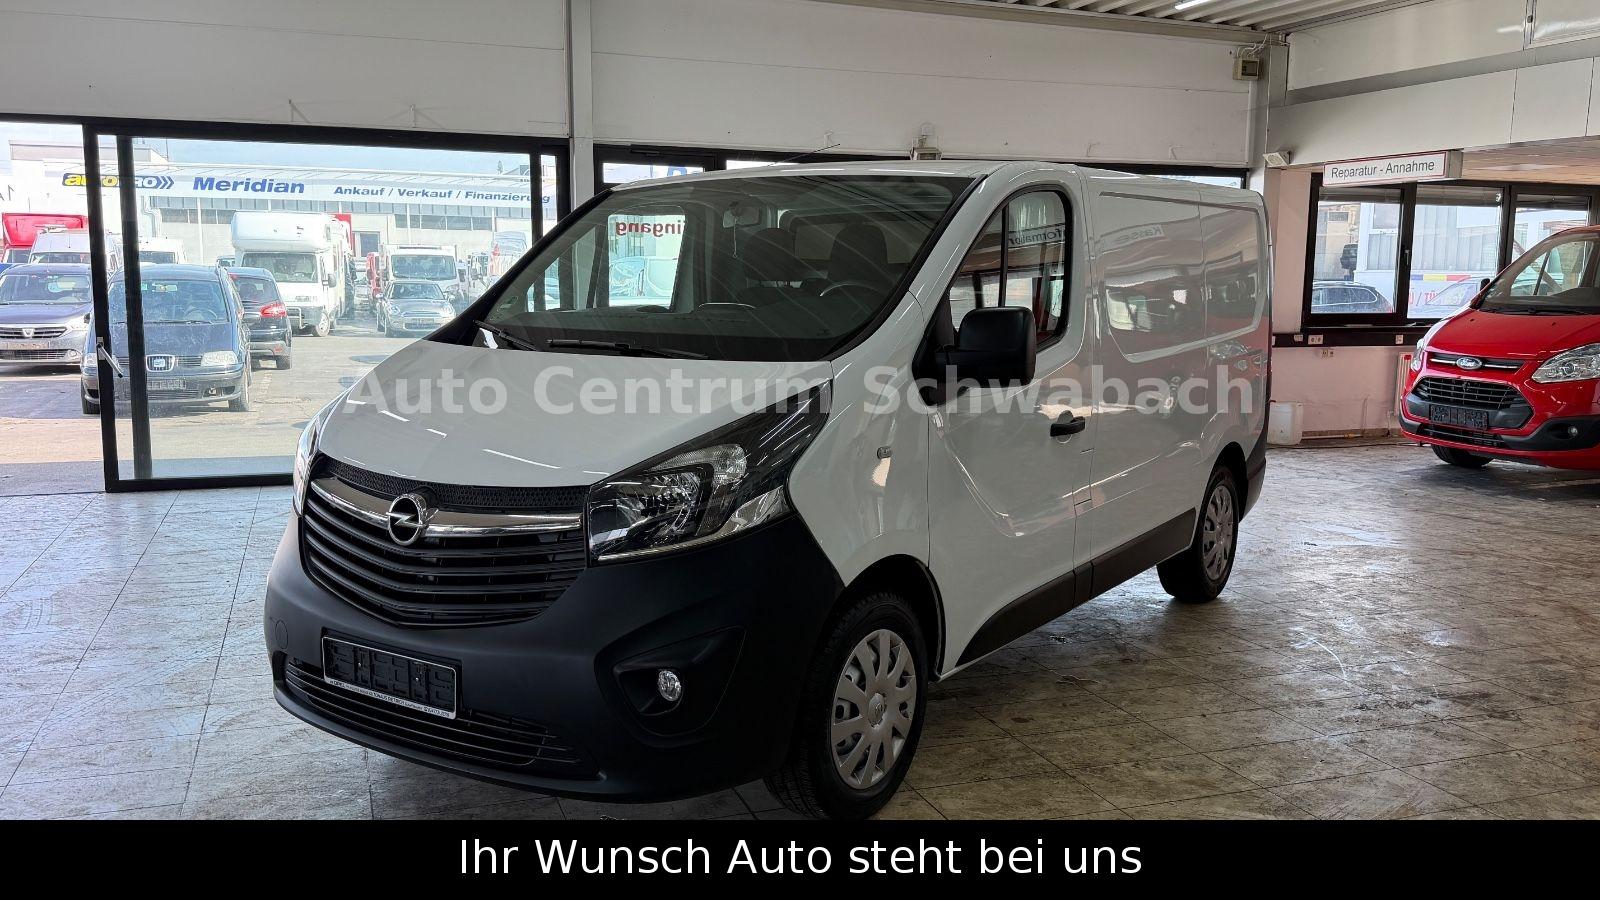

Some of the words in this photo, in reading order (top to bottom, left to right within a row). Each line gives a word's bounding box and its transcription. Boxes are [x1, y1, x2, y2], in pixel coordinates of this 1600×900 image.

[1331, 165, 1377, 180] Reparatur
[1385, 160, 1435, 174] Annahme
[193, 176, 305, 194] Meridian
[333, 186, 385, 196] Ankauf
[398, 188, 454, 199] Verkauf
[465, 190, 551, 203] Finanzierg
